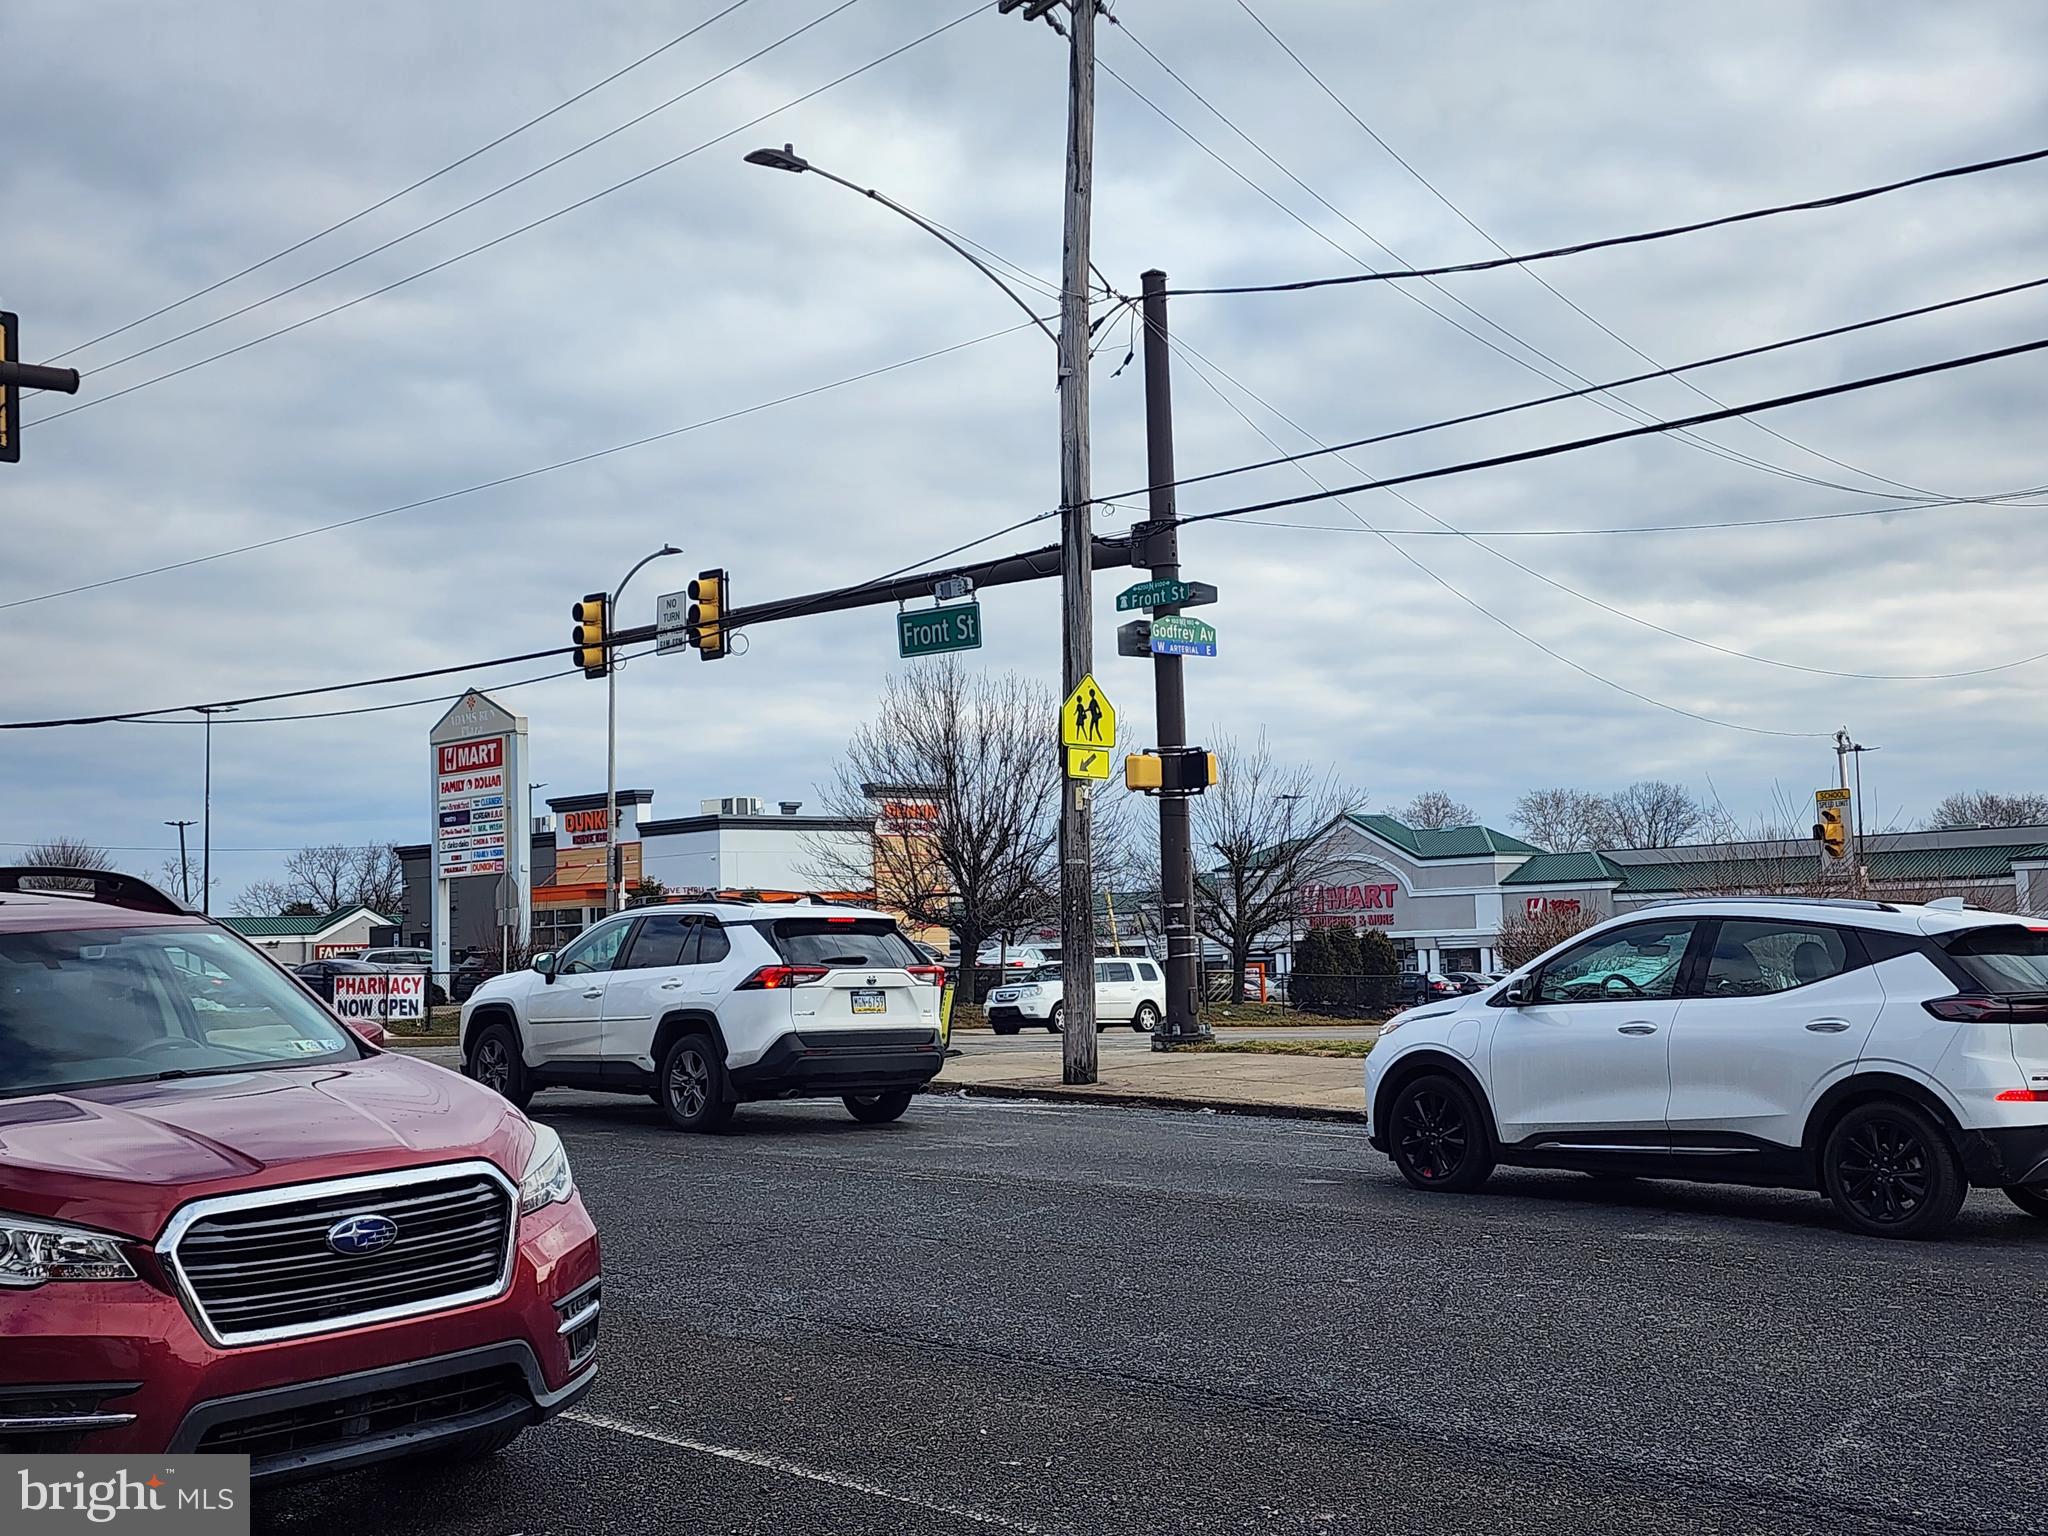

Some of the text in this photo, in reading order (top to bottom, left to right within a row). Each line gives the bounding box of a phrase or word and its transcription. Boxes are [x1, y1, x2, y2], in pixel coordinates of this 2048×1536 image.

[1131, 585, 1185, 608] Front St
[666, 598, 677, 609] NO
[663, 611, 681, 623] TURN
[903, 614, 975, 648] Front St
[1152, 623, 1194, 642] Godfrey
[1200, 627, 1214, 642] Av
[1157, 641, 1212, 655] W ARTERIAL E
[458, 743, 497, 768] MART
[441, 775, 501, 794] FAMILY DOLLAR
[480, 796, 503, 806] CLEANERS
[1820, 791, 1846, 800] SCHOOL
[473, 811, 490, 820] KOREAN
[565, 809, 608, 833] DUNKI
[489, 823, 503, 831] WISH
[472, 835, 504, 846] CHINA TOWN
[473, 850, 489, 859] FAMILY
[443, 865, 468, 875] PHARMACY
[661, 886, 681, 895] RIVE
[1326, 884, 1398, 910] MART
[1367, 913, 1395, 926] MORE
[335, 976, 422, 995] PHARMACY
[338, 999, 419, 1017] NOW OPEN
